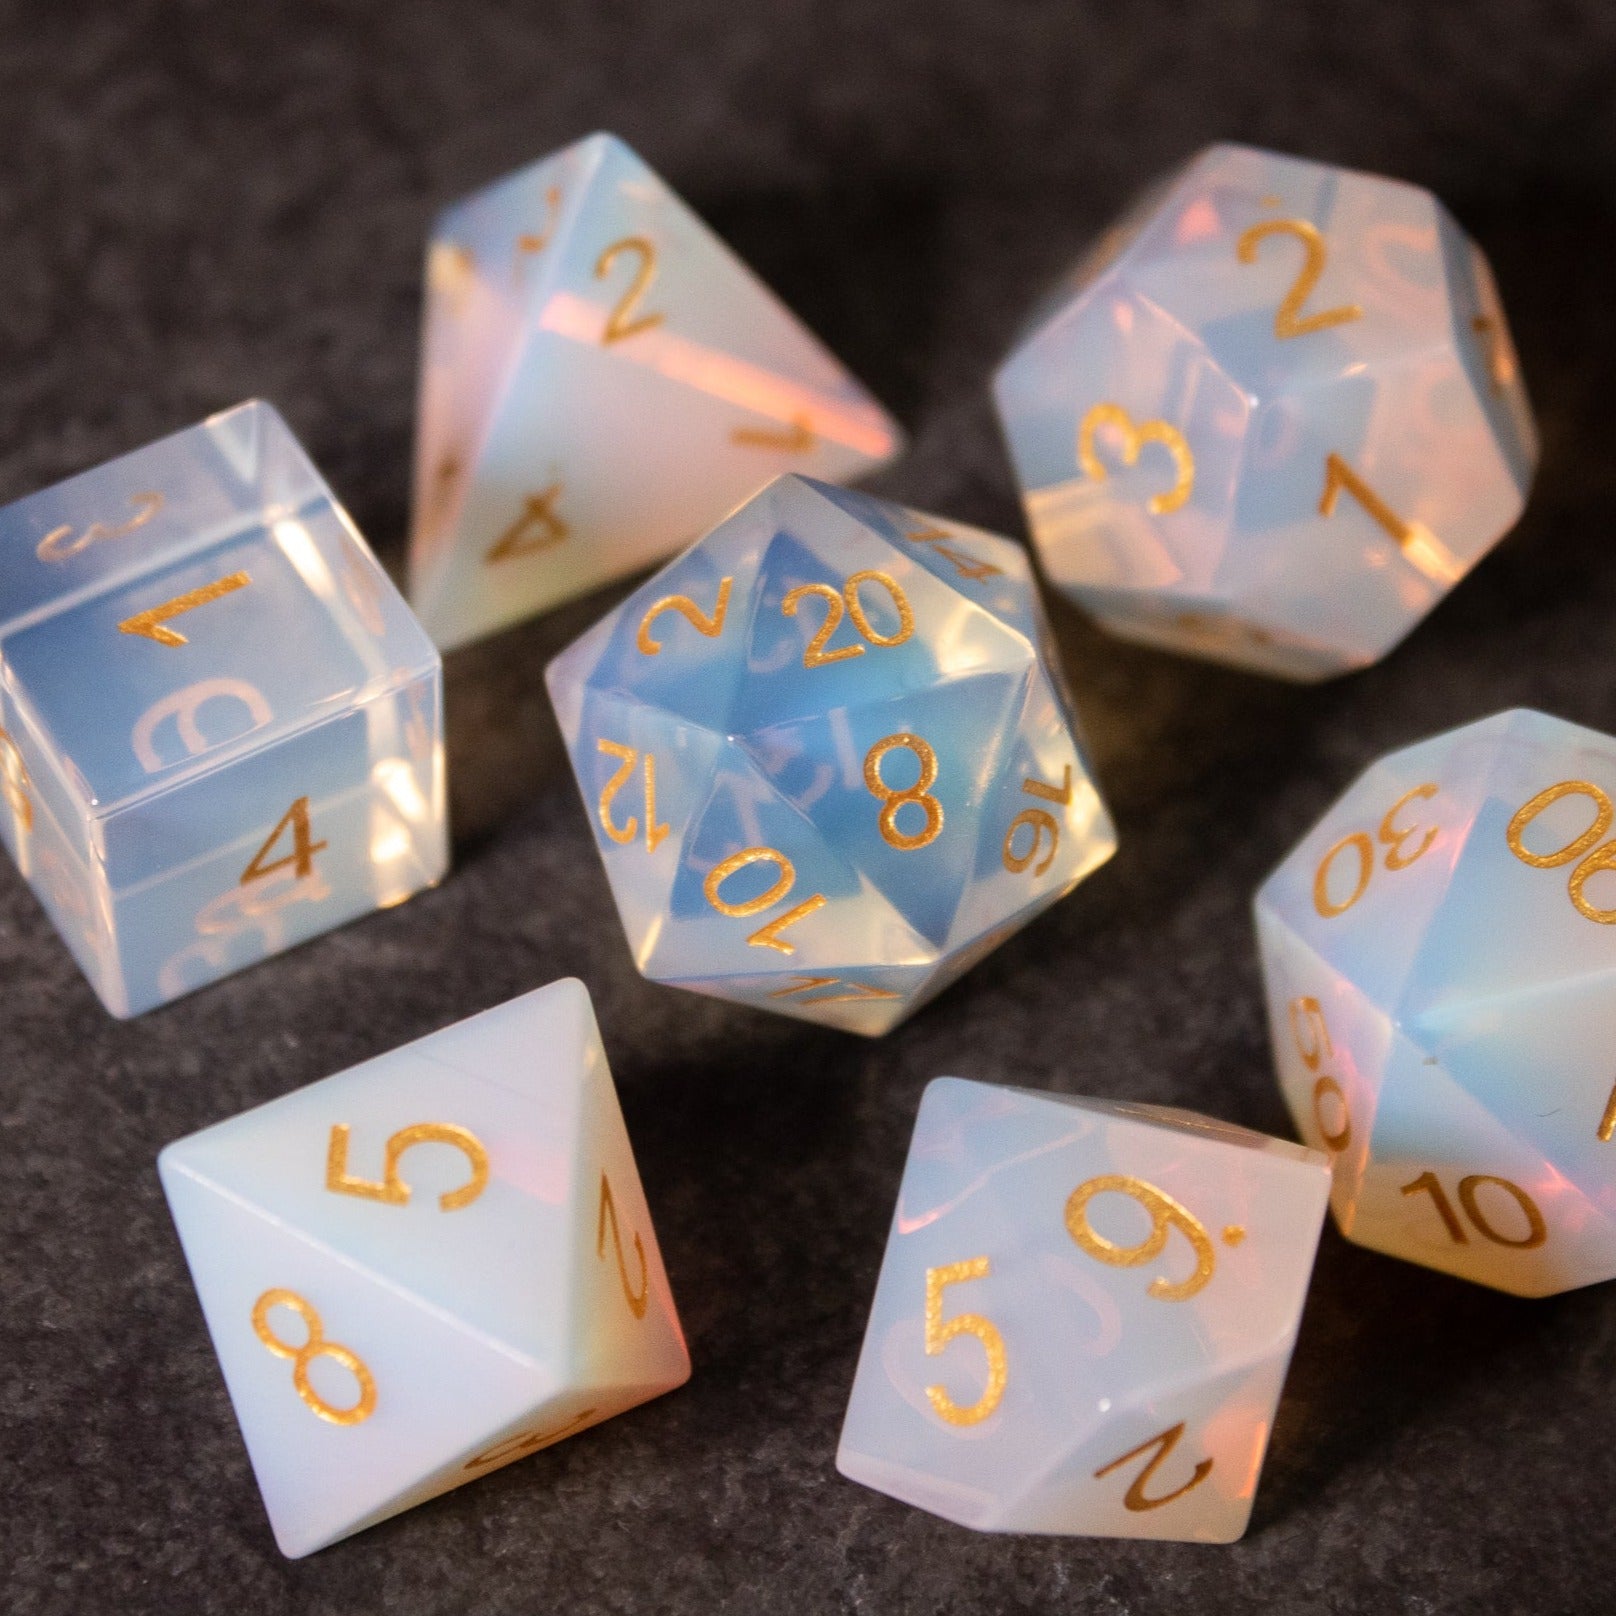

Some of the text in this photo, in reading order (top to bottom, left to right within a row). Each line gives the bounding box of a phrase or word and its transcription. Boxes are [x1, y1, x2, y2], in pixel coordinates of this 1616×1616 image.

[594, 235, 666, 349] 2
[1236, 219, 1367, 340] 2
[1077, 403, 1195, 514] 3
[118, 570, 252, 648] 1
[637, 576, 734, 656] 2
[782, 569, 915, 669] 20
[240, 796, 329, 886] 4
[597, 738, 670, 855] 12
[863, 732, 945, 851] 8
[1002, 763, 1074, 878] 16
[703, 846, 828, 956] 10
[1313, 783, 1440, 919] 30
[326, 1122, 490, 1213] 5
[1401, 1171, 1548, 1250] 10
[596, 1173, 650, 1322] 2
[251, 1287, 378, 1427] 8
[925, 1256, 1009, 1429] 5
[1093, 1421, 1214, 1514] 2
